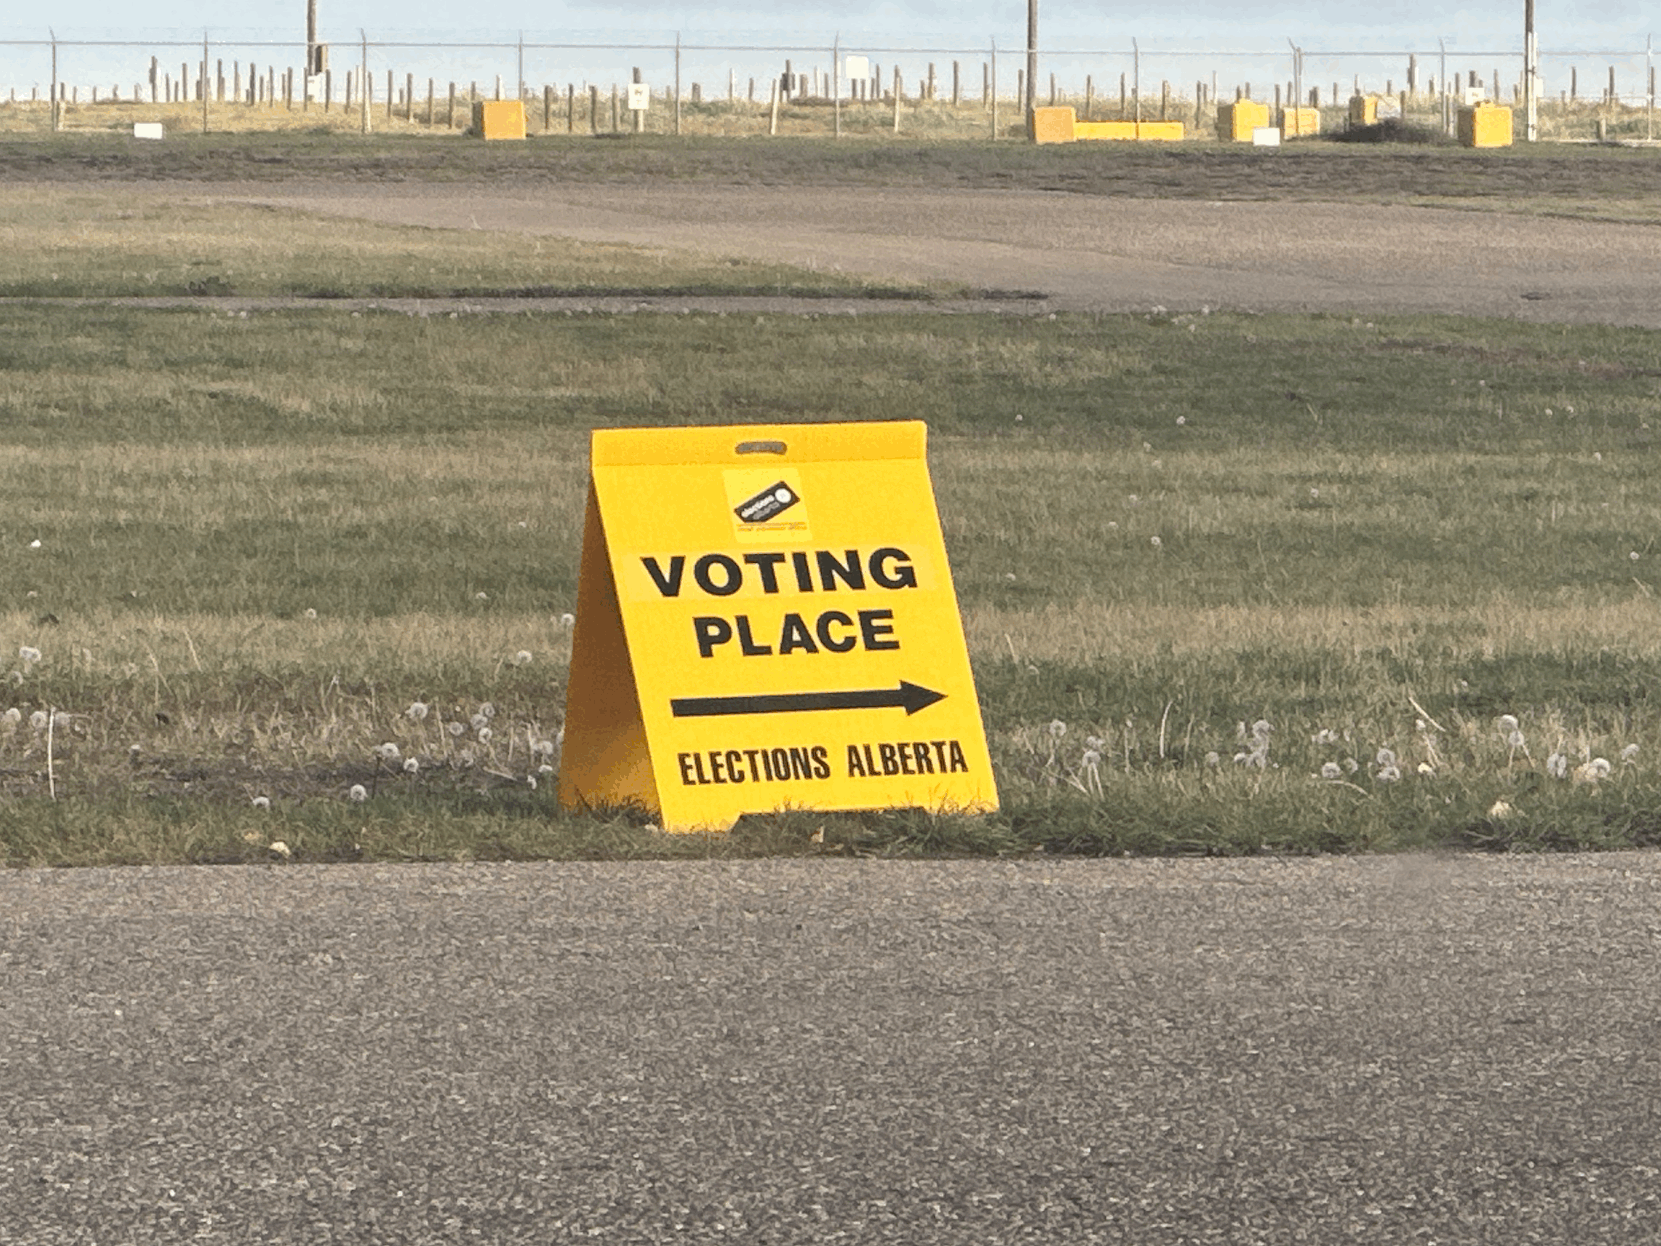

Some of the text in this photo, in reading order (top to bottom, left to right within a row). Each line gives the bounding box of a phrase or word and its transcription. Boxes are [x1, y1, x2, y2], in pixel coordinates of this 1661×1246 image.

[641, 547, 918, 598] VOTING
[693, 609, 900, 658] PLACE
[678, 740, 969, 786] ELECTIONS ALBERTA
